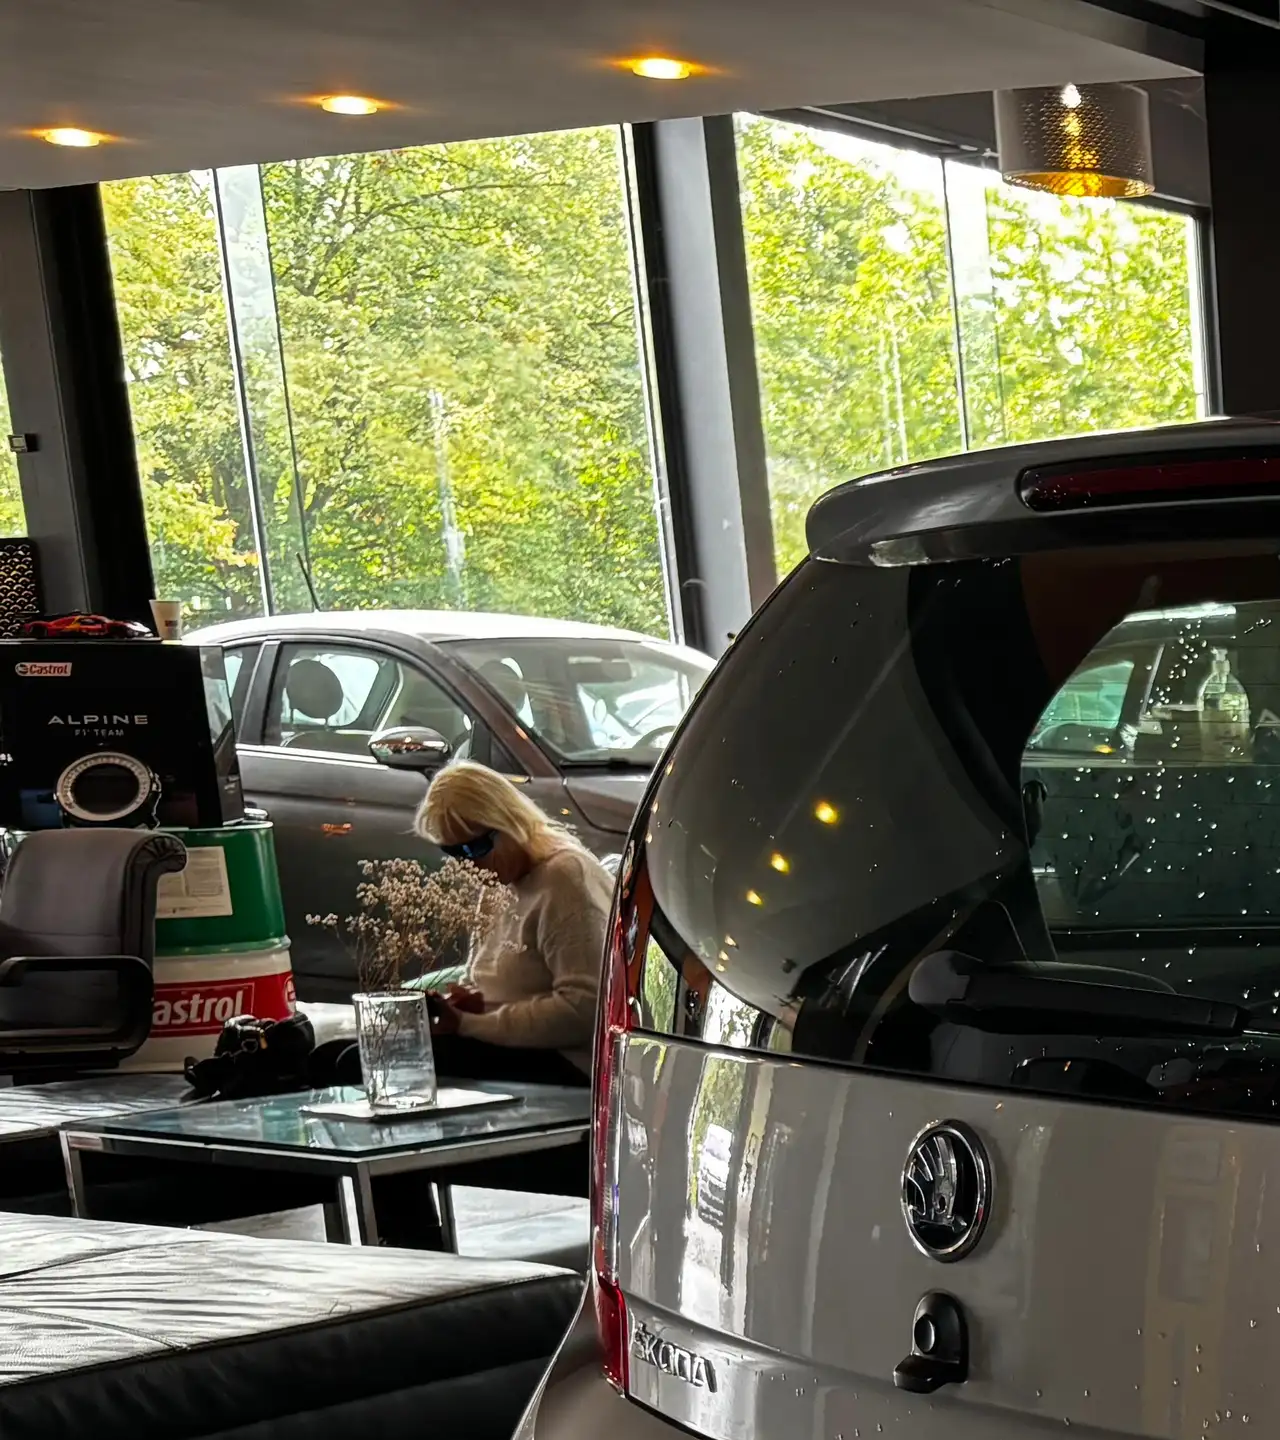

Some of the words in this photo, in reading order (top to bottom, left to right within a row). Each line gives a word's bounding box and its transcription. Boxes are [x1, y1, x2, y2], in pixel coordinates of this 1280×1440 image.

[29, 664, 68, 675] Castrol
[48, 715, 148, 725] ALPINE
[151, 990, 244, 1026] astrol
